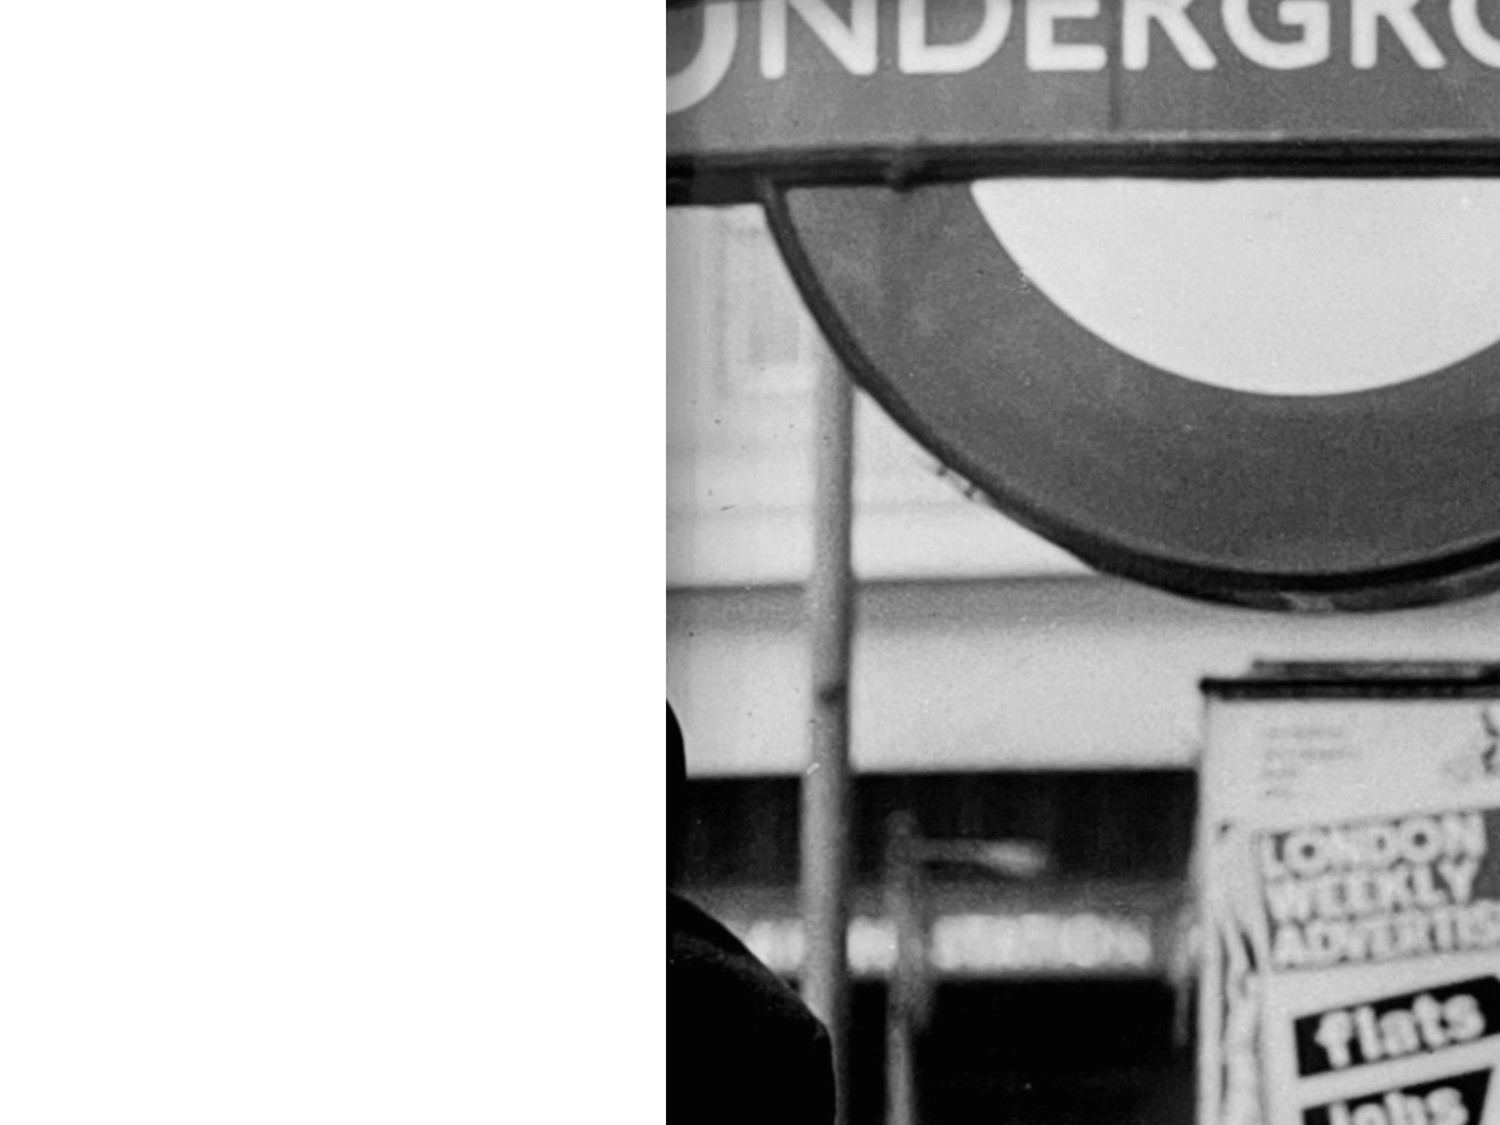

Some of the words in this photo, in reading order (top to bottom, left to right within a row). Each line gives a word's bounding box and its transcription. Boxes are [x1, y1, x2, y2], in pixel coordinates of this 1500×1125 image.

[1261, 812, 1486, 878] LONDON
[1263, 856, 1480, 922] WEEKLY
[1314, 993, 1487, 1069] flats
